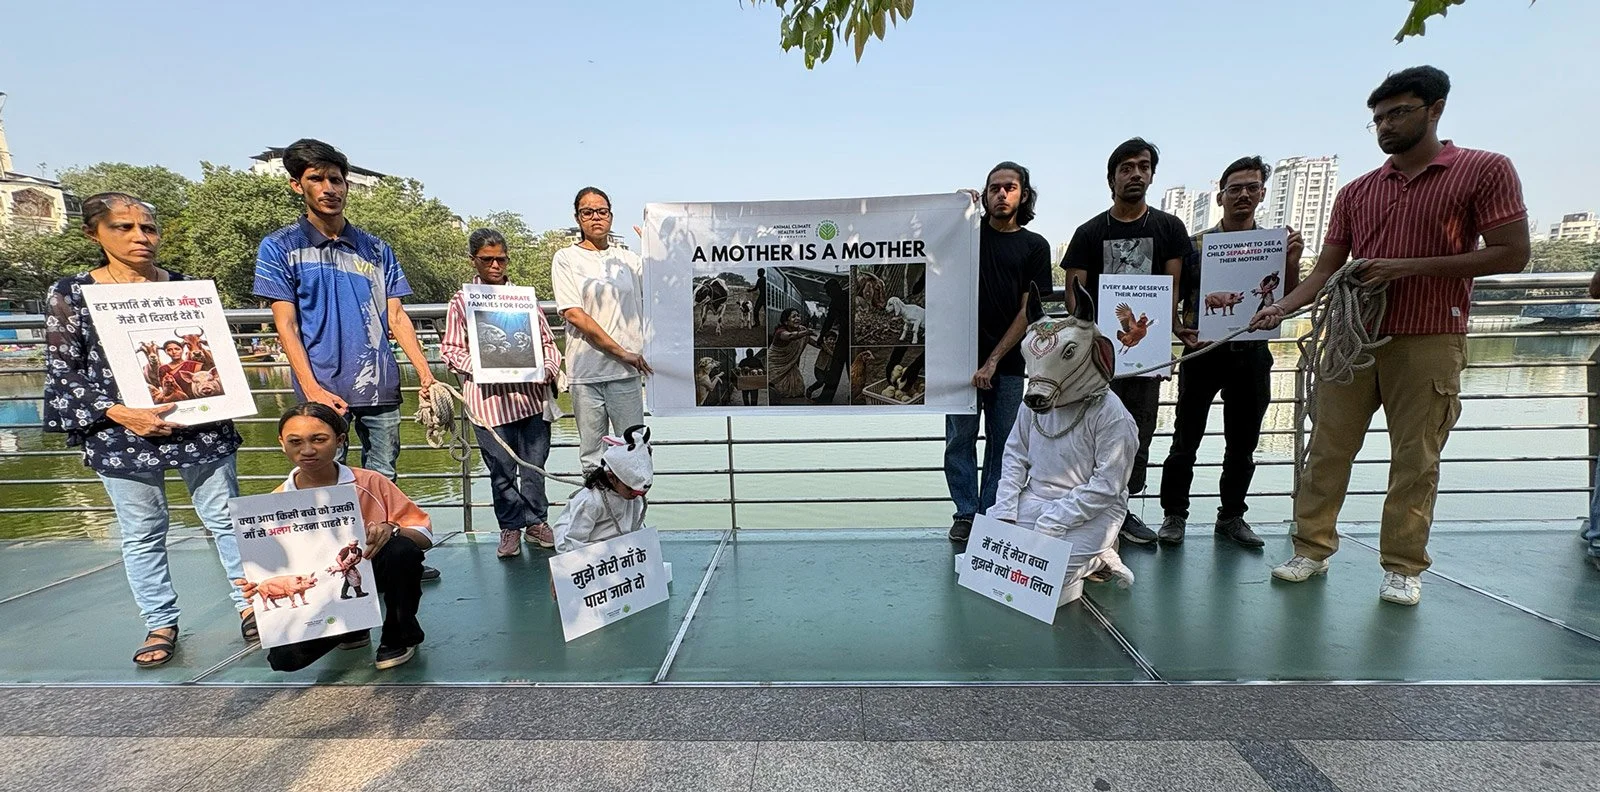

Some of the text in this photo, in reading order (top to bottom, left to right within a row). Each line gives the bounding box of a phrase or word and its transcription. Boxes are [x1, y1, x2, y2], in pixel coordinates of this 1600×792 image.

[691, 240, 927, 263] A MOTHER IS A MOTHER
[1226, 248, 1262, 256] SEPARATED
[1237, 255, 1269, 263] MOTHER?
[93, 294, 213, 311] हर प्रजाति में माँ के आँसू एक
[116, 313, 136, 324] जैसे
[136, 312, 148, 323] ही
[148, 311, 179, 322] दिखाई
[179, 310, 193, 320] देते
[238, 501, 355, 525] क्या आप किसी बच्चे को उसकी
[242, 527, 256, 539] माँ
[256, 528, 267, 537] से
[267, 525, 291, 536] अलग
[292, 522, 319, 532] देखना
[320, 517, 341, 527] चाहते
[982, 536, 1049, 572] मैं माँ हूँ मेरा बच्चा
[571, 547, 647, 589] मुझे मेरी माँ के
[971, 555, 1054, 597] मुझसे क्यों छीन लिया
[583, 573, 646, 608] पास जाने दो
